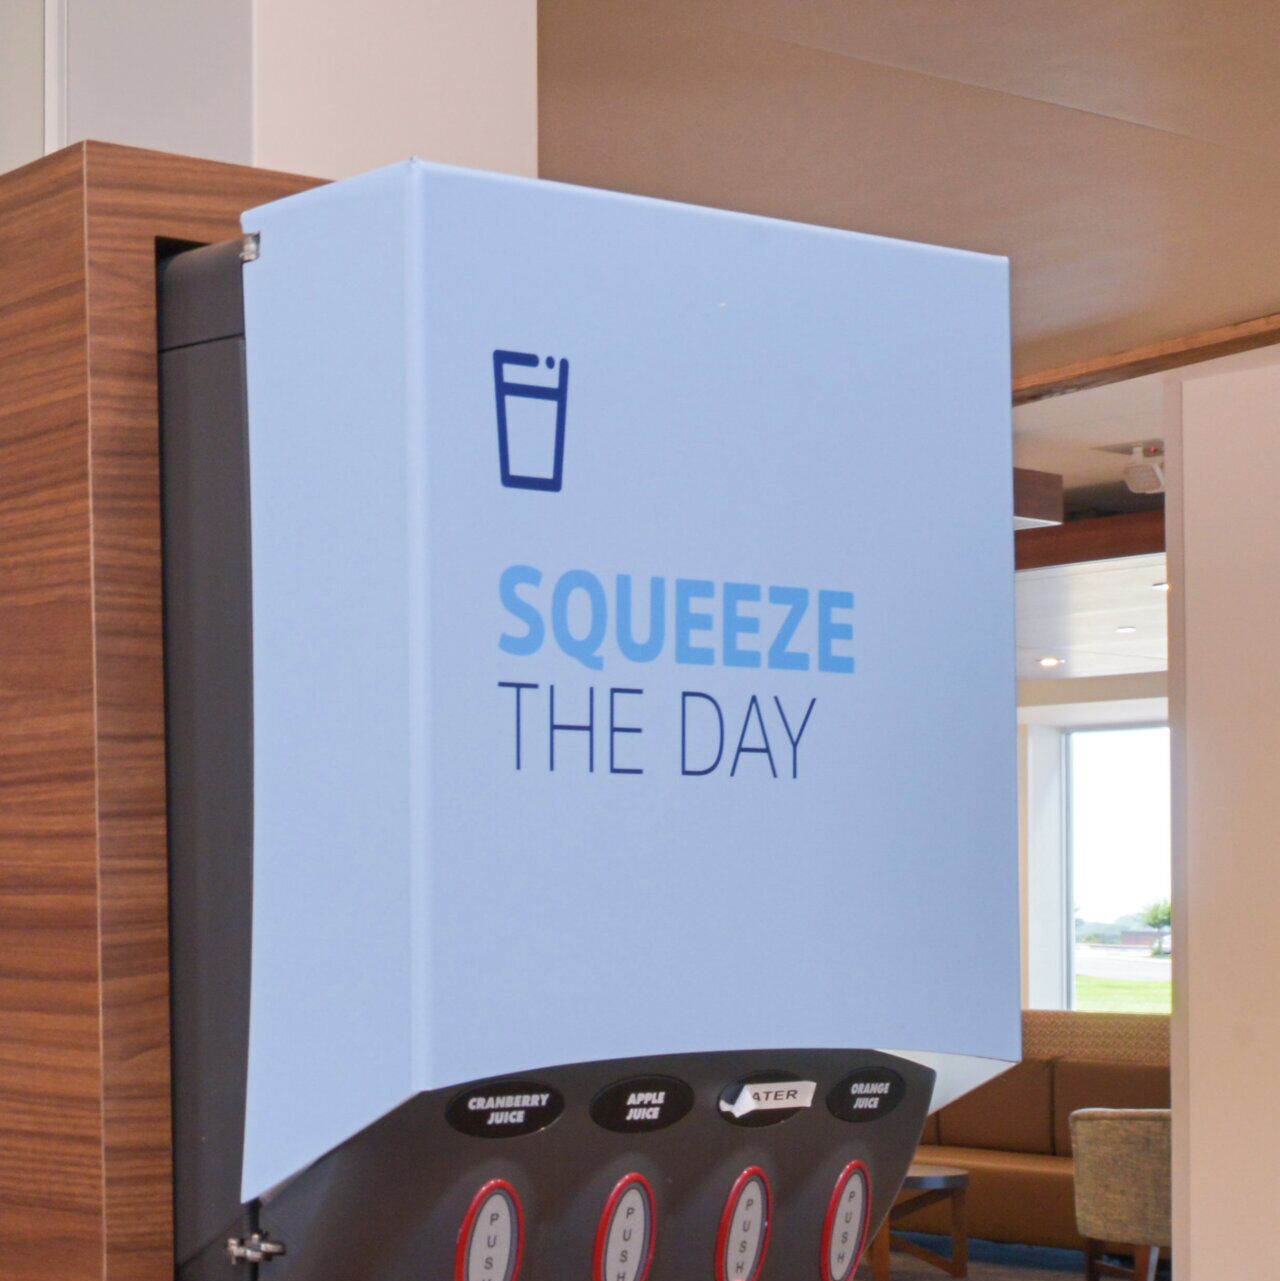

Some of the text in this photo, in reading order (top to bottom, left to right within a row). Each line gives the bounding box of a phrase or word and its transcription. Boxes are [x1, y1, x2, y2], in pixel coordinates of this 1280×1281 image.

[497, 563, 856, 675] SQUEEZE
[497, 681, 817, 780] THE DAY
[751, 1088, 799, 1103] ATER
[850, 1082, 891, 1096] ORANGE
[467, 1092, 551, 1111] CRANBERRY
[626, 1091, 666, 1106] APPLE
[853, 1096, 881, 1109] JUICE
[487, 1110, 525, 1125] JUICE
[626, 1107, 660, 1121] JUICE
[837, 1190, 857, 1265] PUSH
[735, 1198, 755, 1274] PUSH
